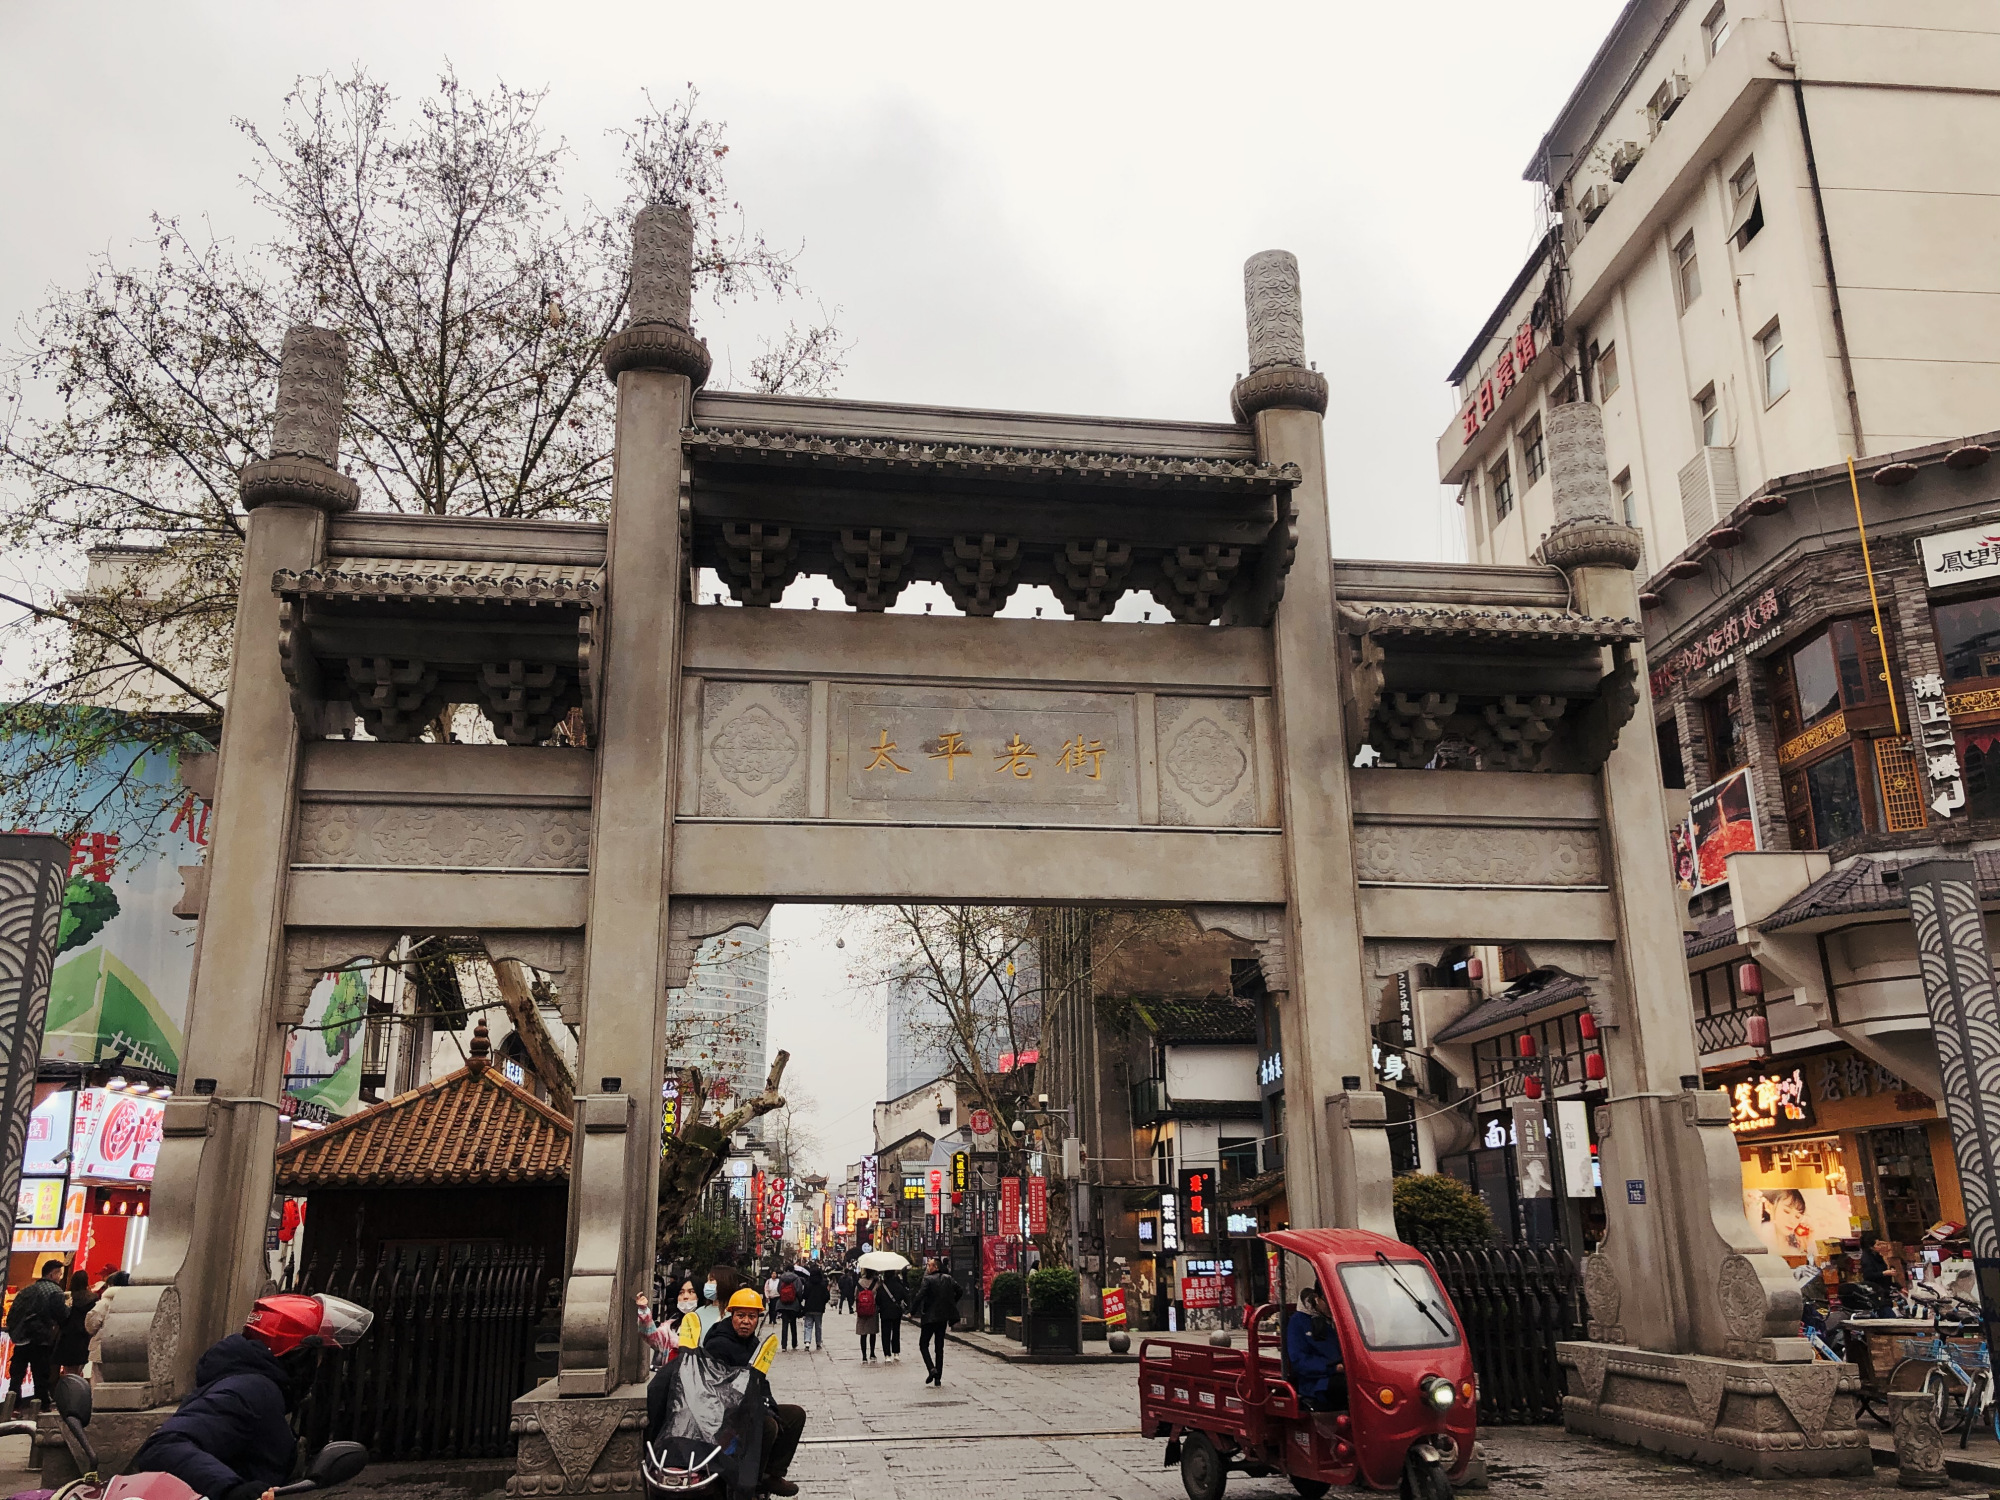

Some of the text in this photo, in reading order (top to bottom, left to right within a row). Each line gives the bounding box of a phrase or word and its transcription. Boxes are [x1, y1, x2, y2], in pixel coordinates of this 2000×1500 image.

[864, 729, 1107, 780] 太平老街
[1912, 674, 1960, 780] 请上二楼
